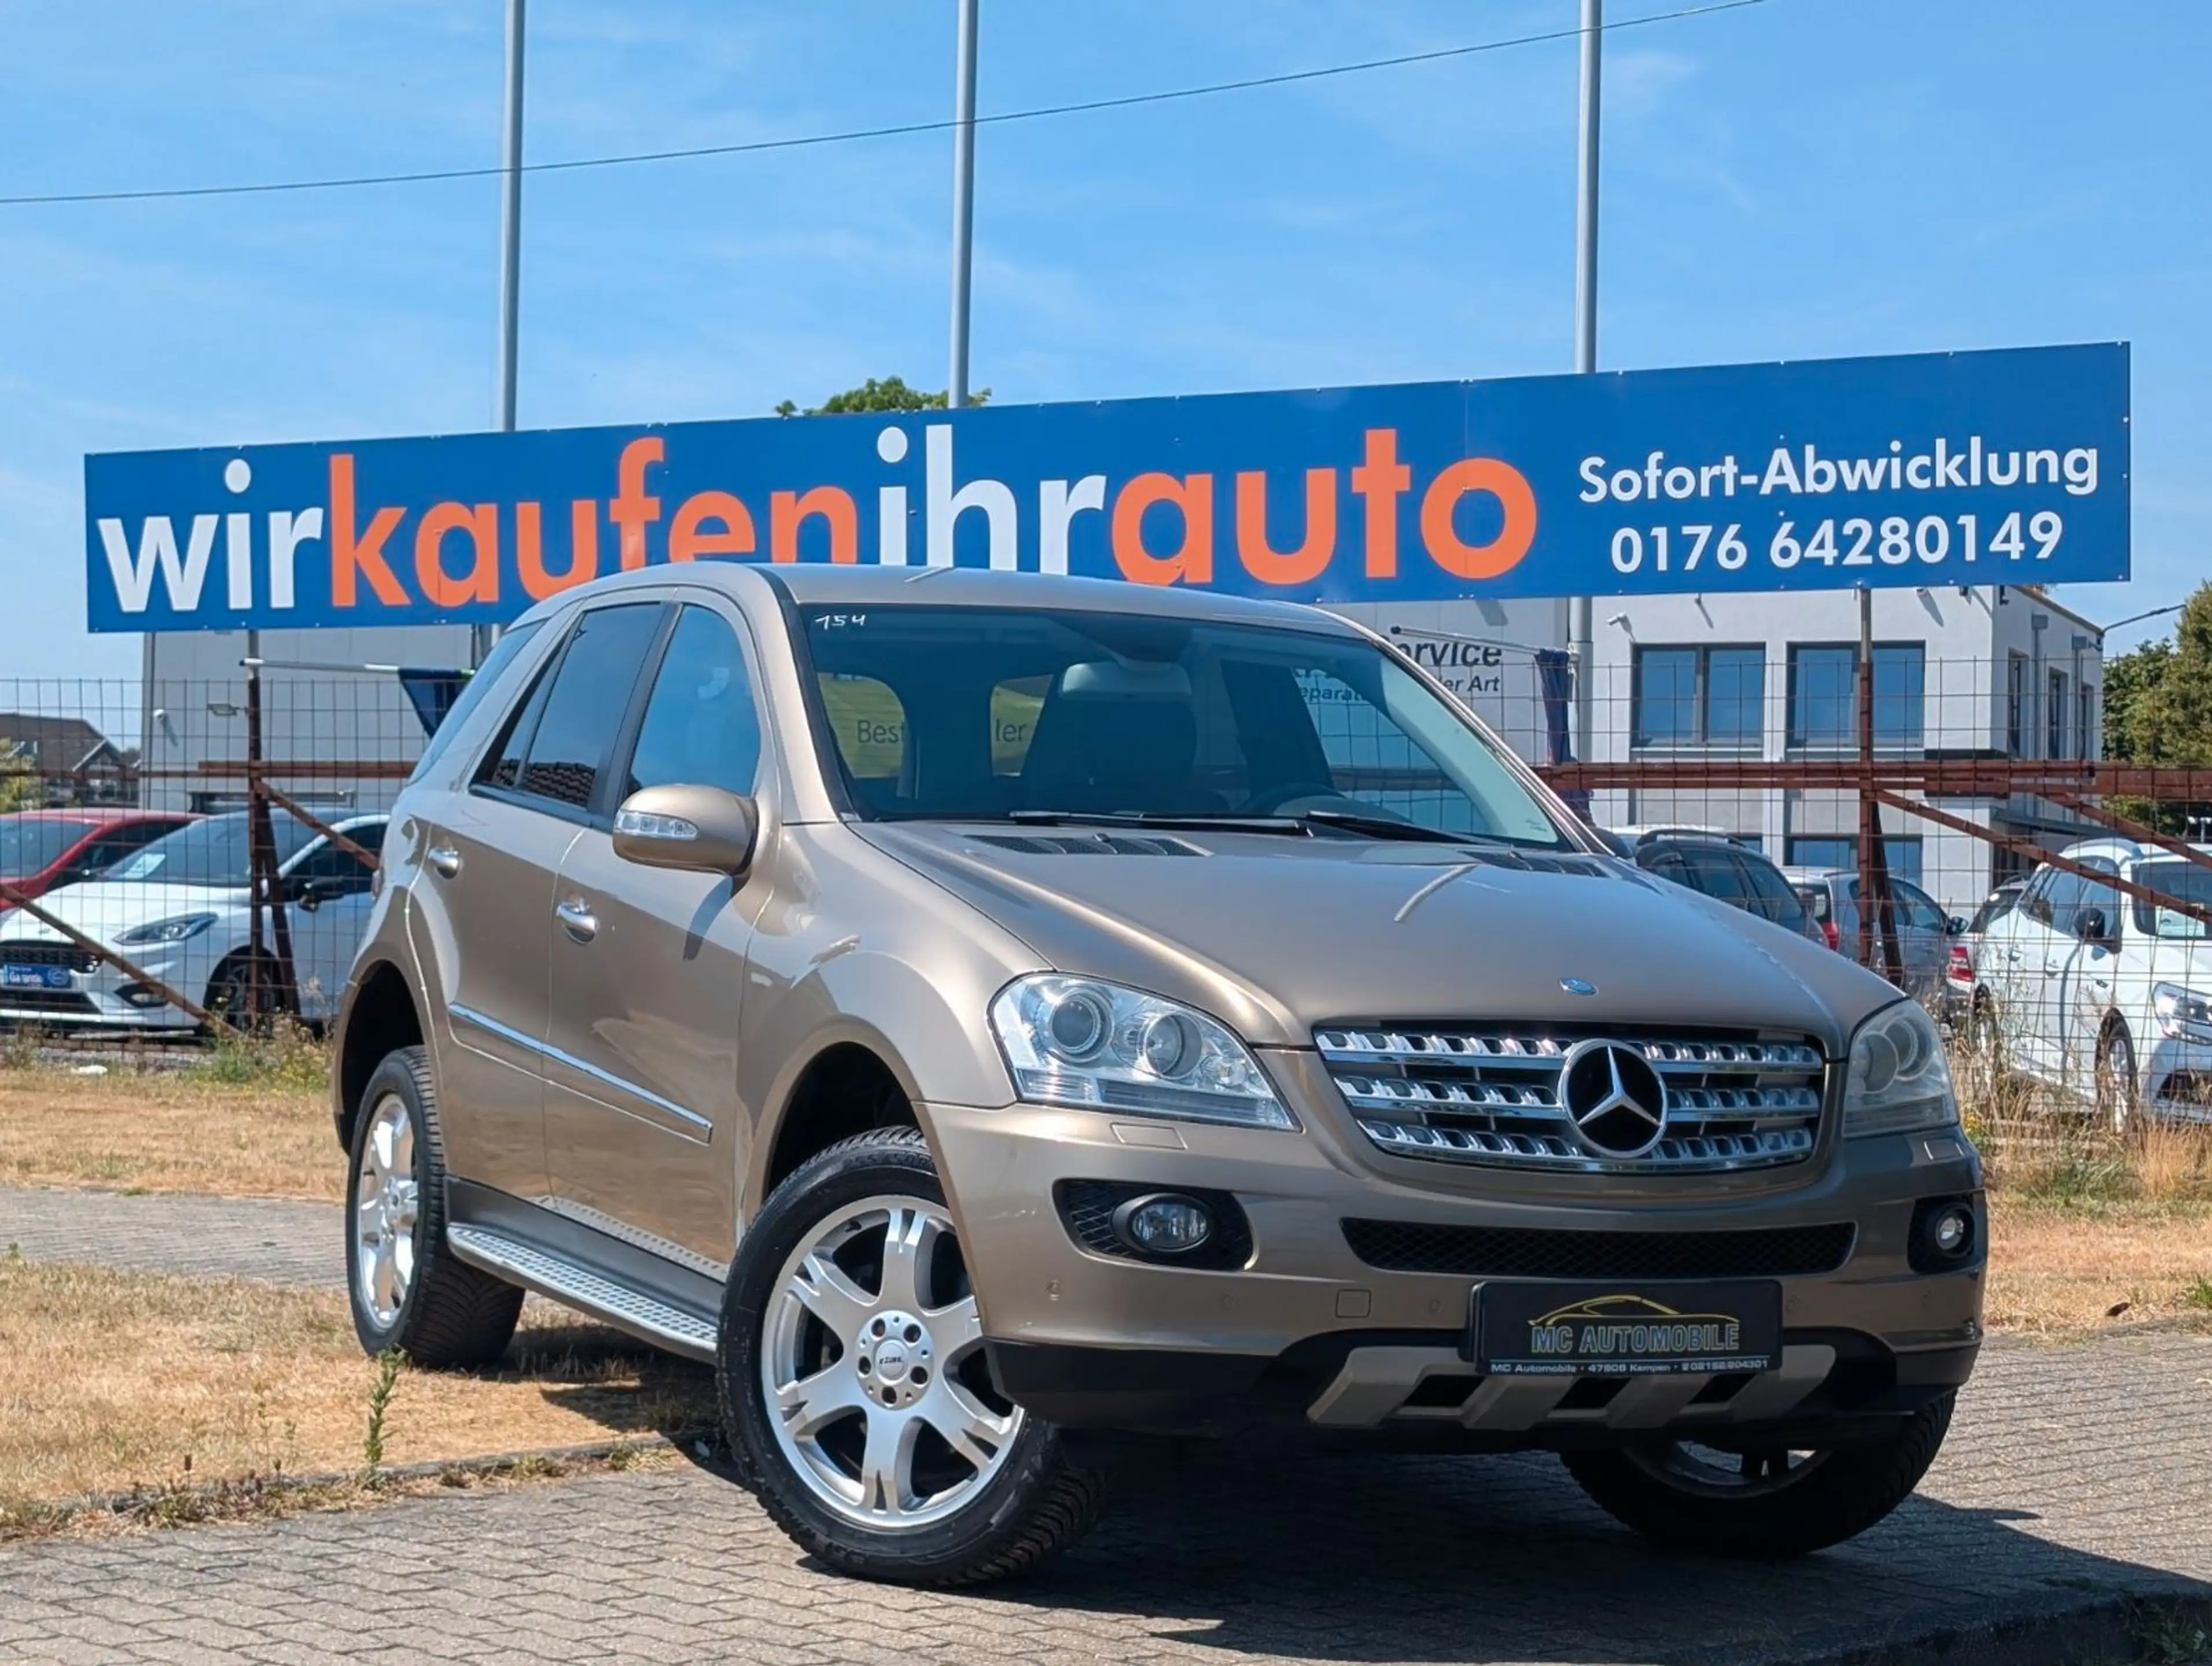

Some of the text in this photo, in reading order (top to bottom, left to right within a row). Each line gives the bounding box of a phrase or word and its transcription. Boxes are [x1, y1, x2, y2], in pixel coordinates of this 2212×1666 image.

[1578, 436, 2099, 502] Sofort-Abwicklung
[1611, 510, 2063, 573] 0176 64280149
[815, 614, 866, 631] 154
[1467, 669, 1500, 692] Art
[1532, 1323, 1740, 1353] MC AUTOMOBILE
[1490, 1363, 1511, 1373] MC
[1515, 1363, 1577, 1373] Automobile
